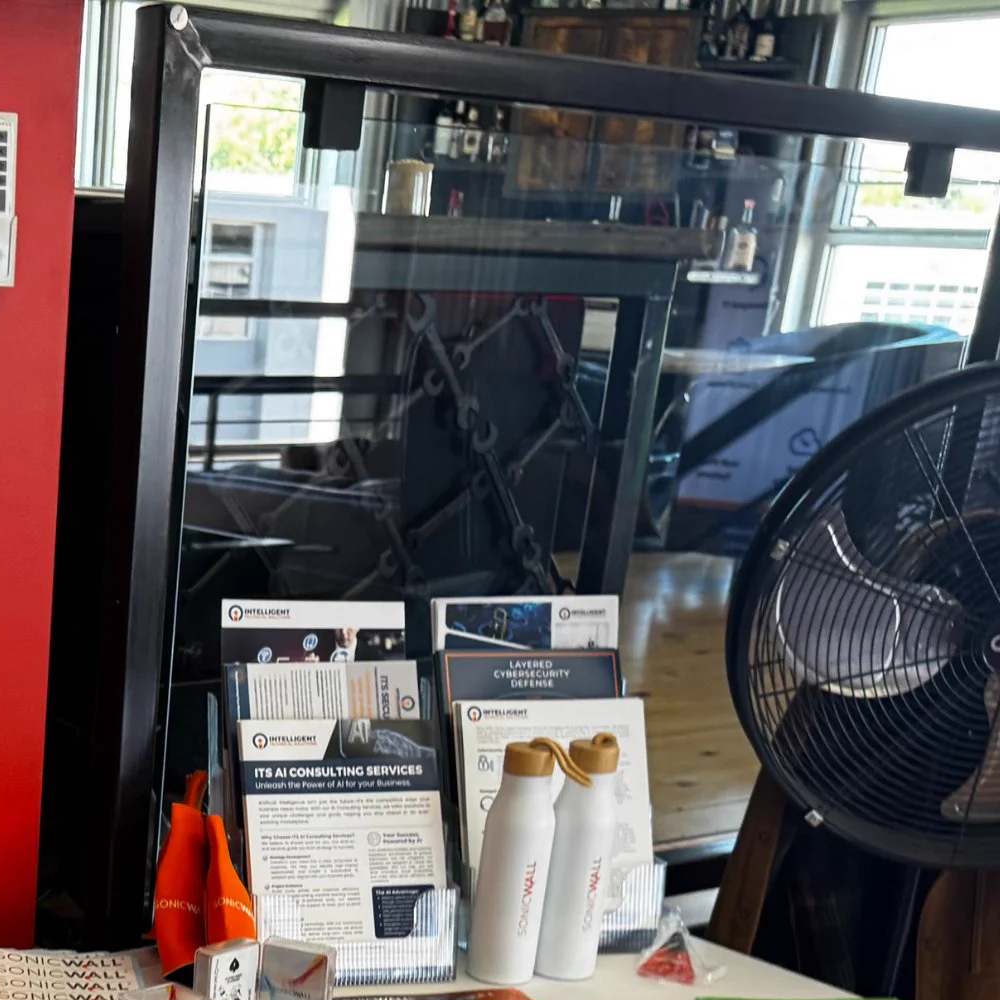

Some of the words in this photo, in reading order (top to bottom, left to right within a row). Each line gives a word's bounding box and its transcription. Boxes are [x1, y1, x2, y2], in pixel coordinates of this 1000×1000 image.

[509, 660, 553, 669] LAYERED
[493, 669, 570, 679] CYBERSECURITY
[510, 679, 554, 688] DEFENSE
[254, 767, 273, 779] ITS
[275, 767, 287, 778] AI
[289, 766, 364, 778] CONSULTING
[366, 764, 423, 776] SERVICES
[255, 781, 286, 790] Unleash
[288, 781, 300, 790] the
[301, 781, 326, 789] Power
[327, 780, 335, 788] of
[336, 780, 344, 788] AI
[345, 780, 357, 788] for
[358, 780, 376, 790] your
[516, 860, 536, 937] SONICWALL
